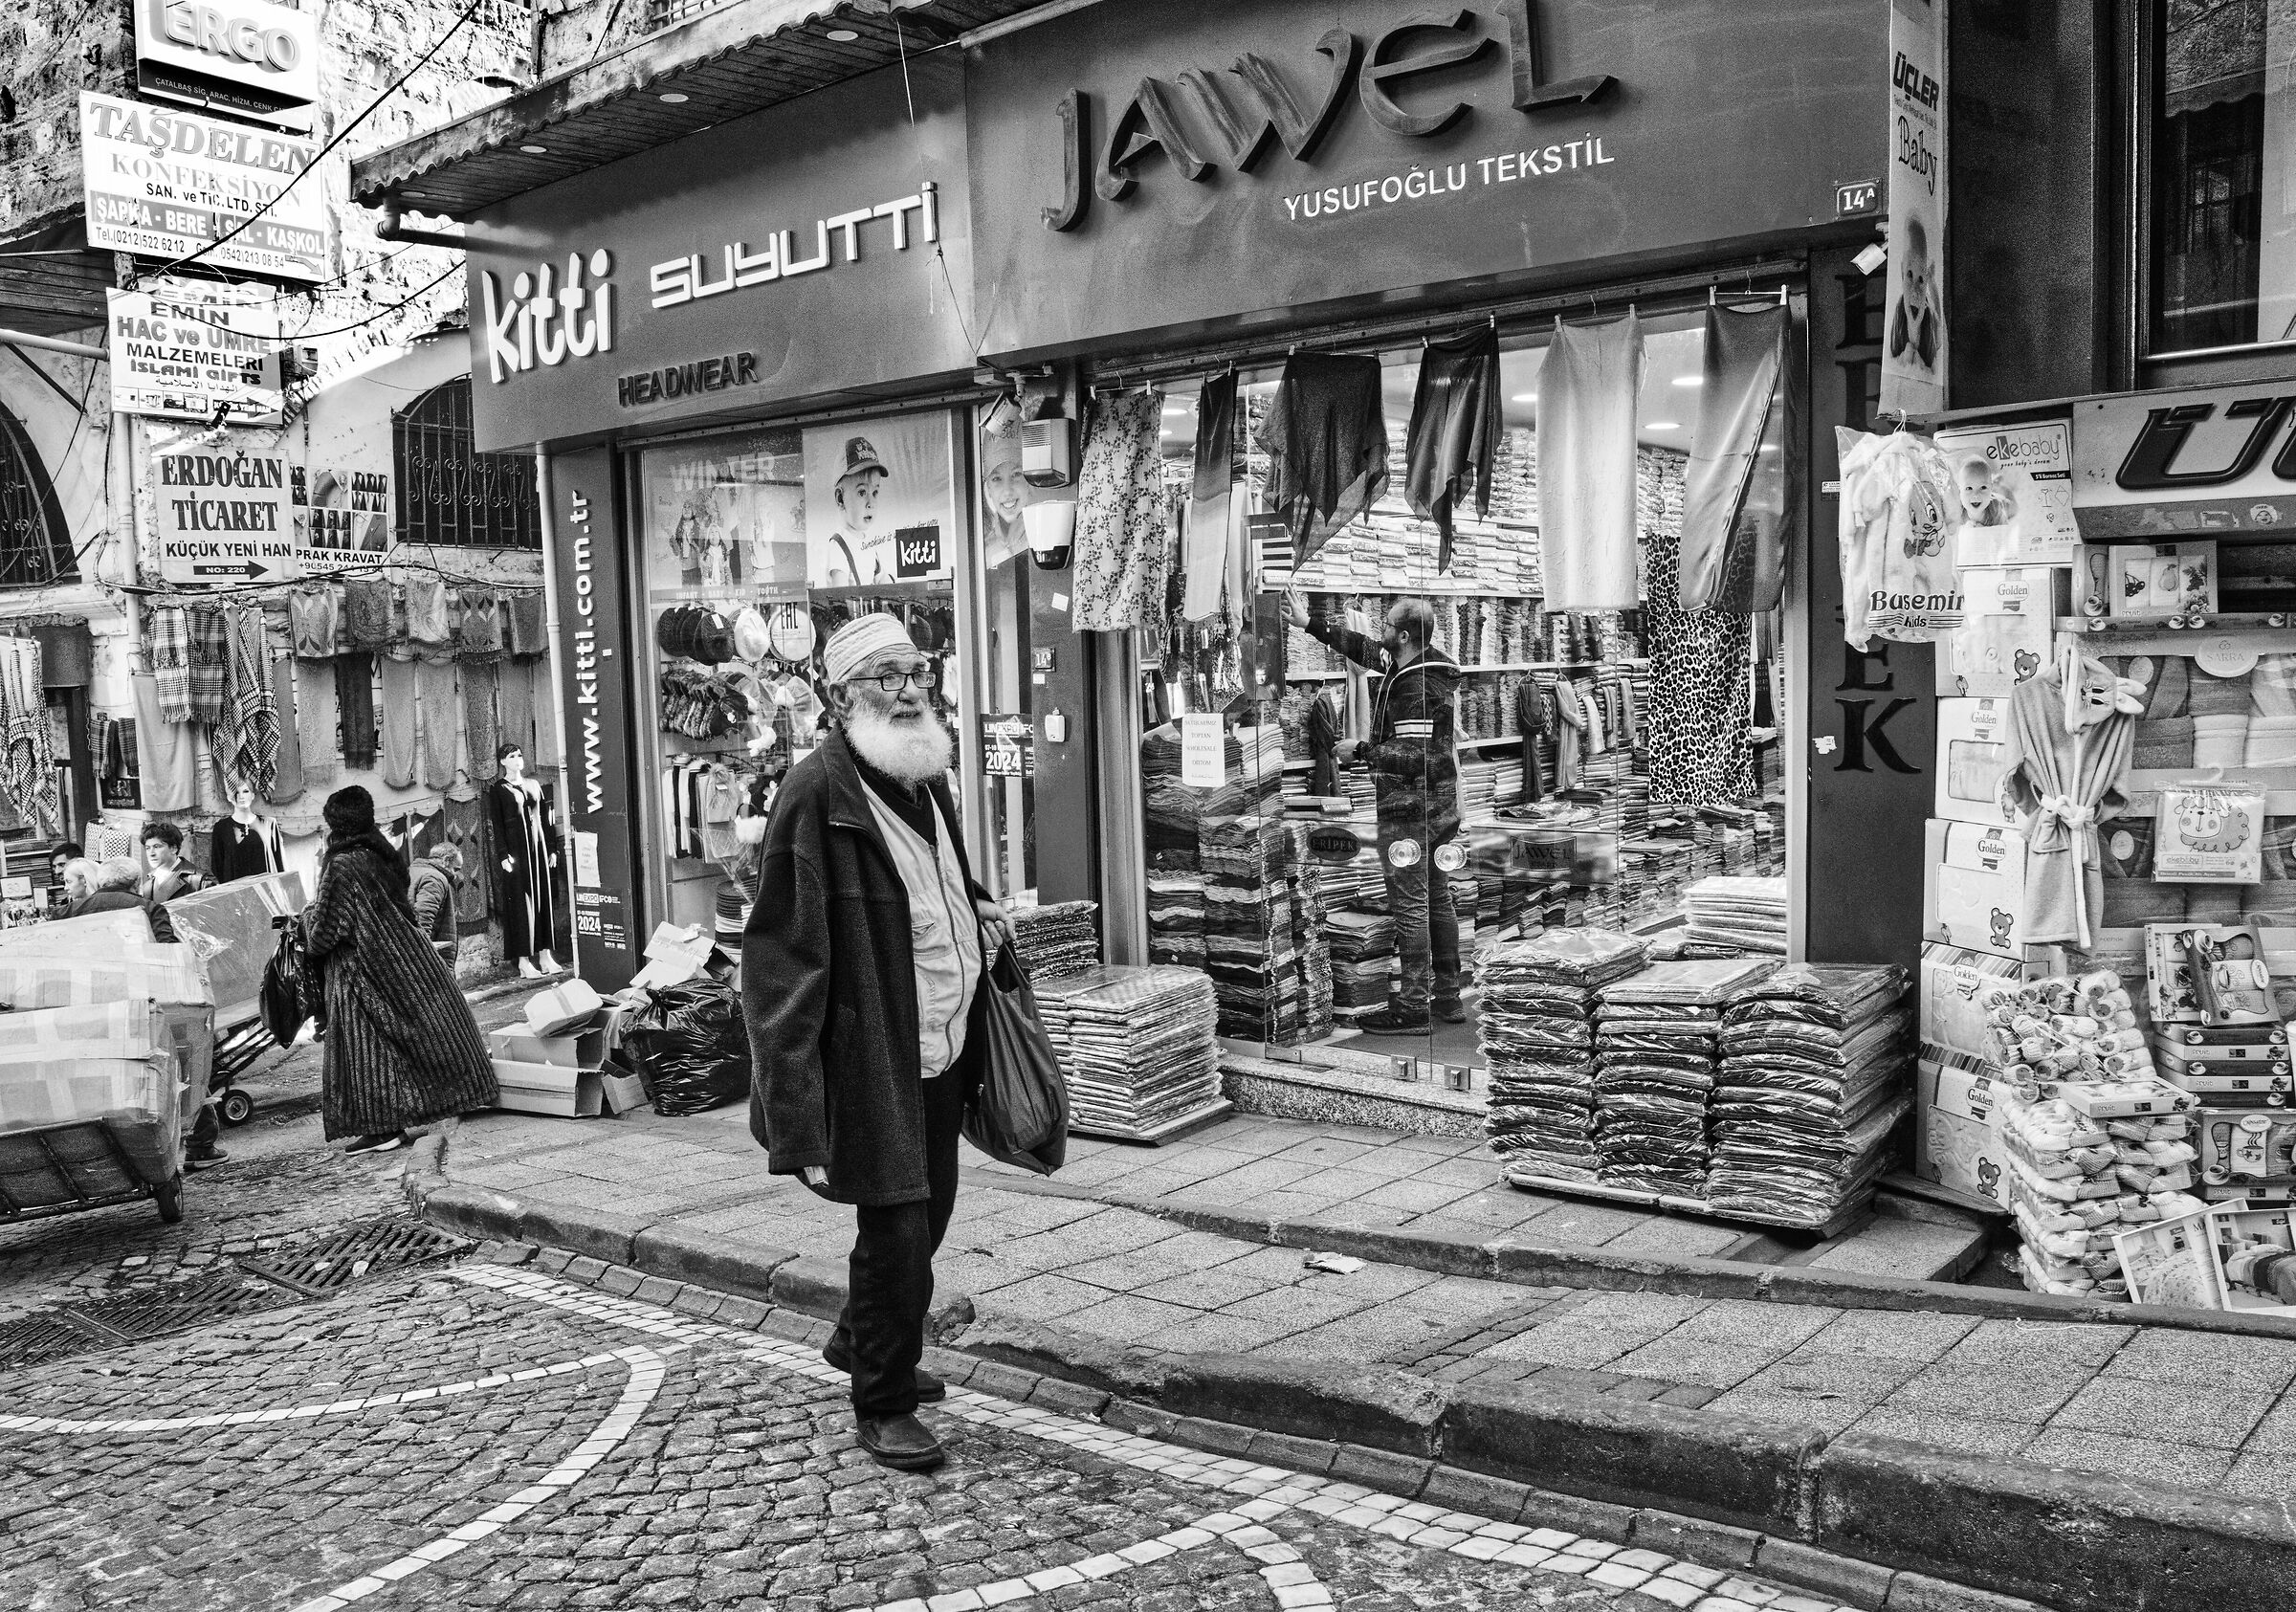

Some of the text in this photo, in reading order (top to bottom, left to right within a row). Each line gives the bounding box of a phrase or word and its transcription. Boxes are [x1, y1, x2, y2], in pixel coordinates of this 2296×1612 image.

[163, 2, 301, 73] ERGO
[1892, 51, 1940, 112] ÜÇLER
[89, 101, 316, 178] TAŞDELEN
[1897, 115, 1938, 196] Baby
[110, 152, 302, 208] KONFEKSİYON
[1283, 131, 1616, 222] YUSUFOĞLU TEKSTİL
[183, 191, 197, 203] ve
[97, 197, 152, 227] ŞAPKA
[166, 210, 208, 236] BERE
[150, 301, 230, 326] EMİN
[482, 248, 612, 385] kitti
[117, 316, 167, 342] HAC
[173, 328, 200, 345] ve
[617, 350, 761, 408] HEADWEAR
[1986, 435, 2060, 460] ekebaby
[161, 451, 283, 489] ERDOĞAN
[171, 492, 278, 532] TİCARET
[166, 541, 292, 561] KÜÇÜK YENİ HAN
[334, 552, 383, 564] KRAVAT
[899, 540, 936, 566] kitti
[1998, 584, 2028, 596] Golden
[569, 489, 603, 814] www.kitti.com.tr
[1971, 712, 1997, 725] Golden
[985, 751, 1022, 770] 2024
[1977, 839, 2005, 855] Golden
[578, 916, 601, 932] 2024
[1954, 965, 1977, 982] Golden
[1968, 1088, 1994, 1107] Golden
